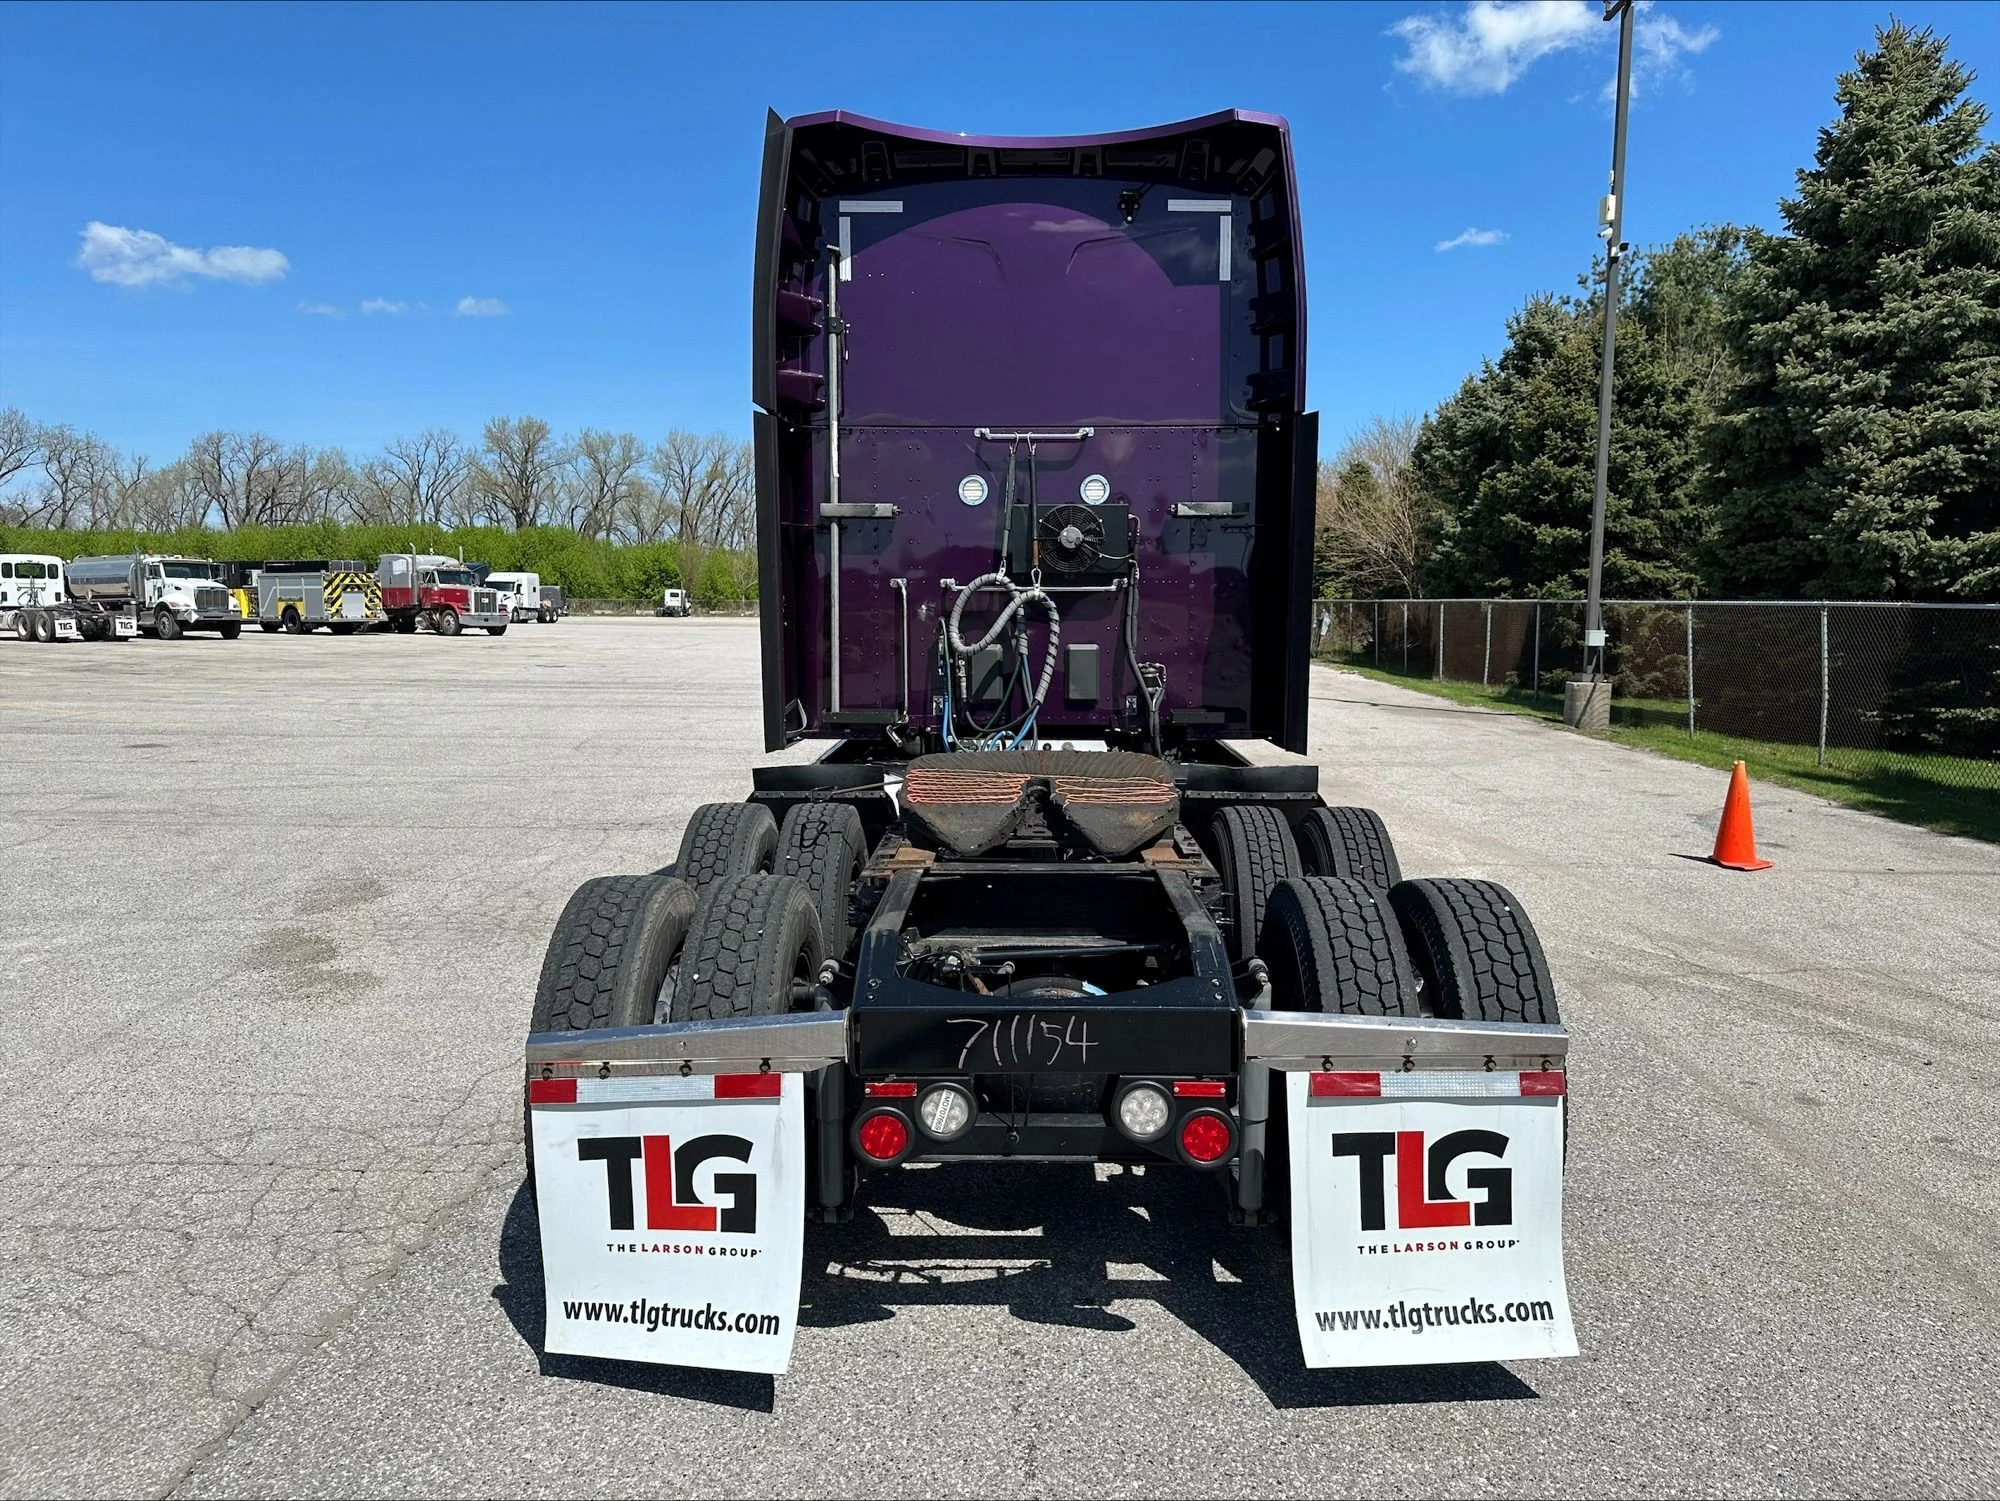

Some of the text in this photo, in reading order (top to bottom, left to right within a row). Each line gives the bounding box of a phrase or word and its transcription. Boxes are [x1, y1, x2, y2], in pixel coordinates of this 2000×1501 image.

[945, 1013, 1099, 1070] 711154
[577, 1134, 757, 1235] TLG
[1331, 1129, 1513, 1232] TLG
[606, 1243, 758, 1258] THE LARSON GROUP
[1357, 1239, 1516, 1255] THE LARSON GROUP
[562, 1297, 780, 1336] www.tlgtrucks.com
[1314, 1296, 1554, 1334] www.tlgtrucks.com
